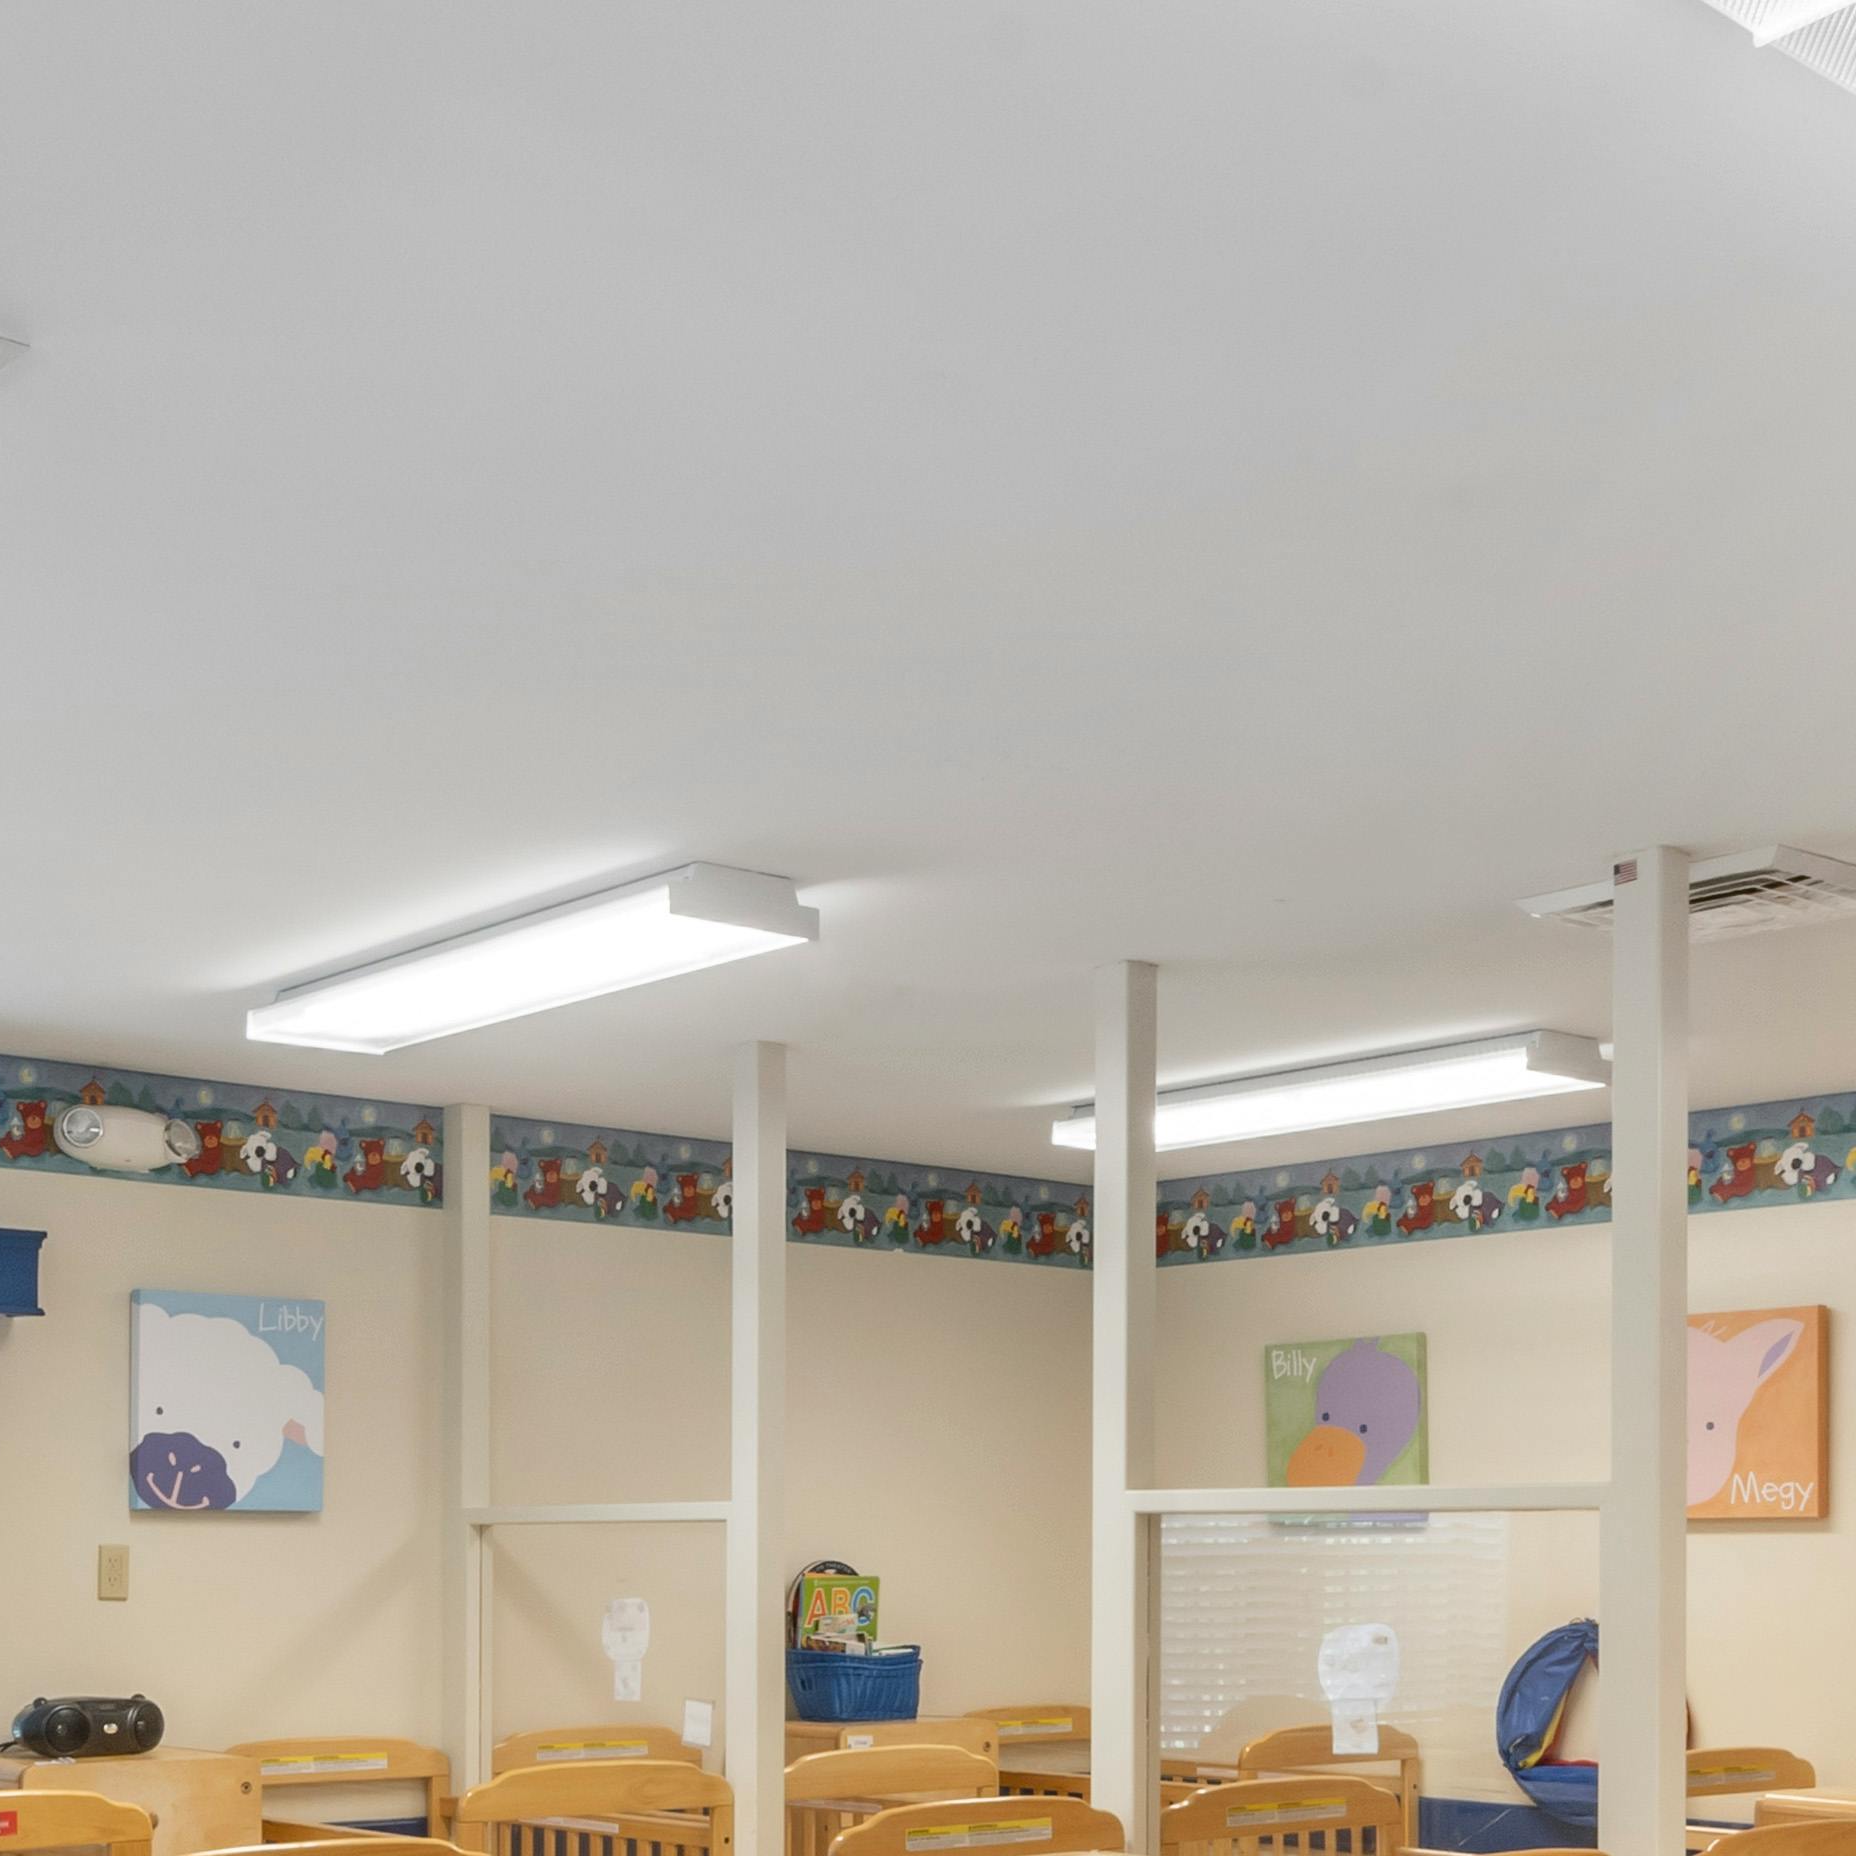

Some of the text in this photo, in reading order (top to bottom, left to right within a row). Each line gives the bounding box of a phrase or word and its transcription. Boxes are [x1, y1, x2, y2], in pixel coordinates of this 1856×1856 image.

[258, 1302, 324, 1341] Libby
[1271, 1349, 1318, 1384] Billy
[1730, 1470, 1815, 1512] Megy
[804, 1586, 876, 1628] ABC
